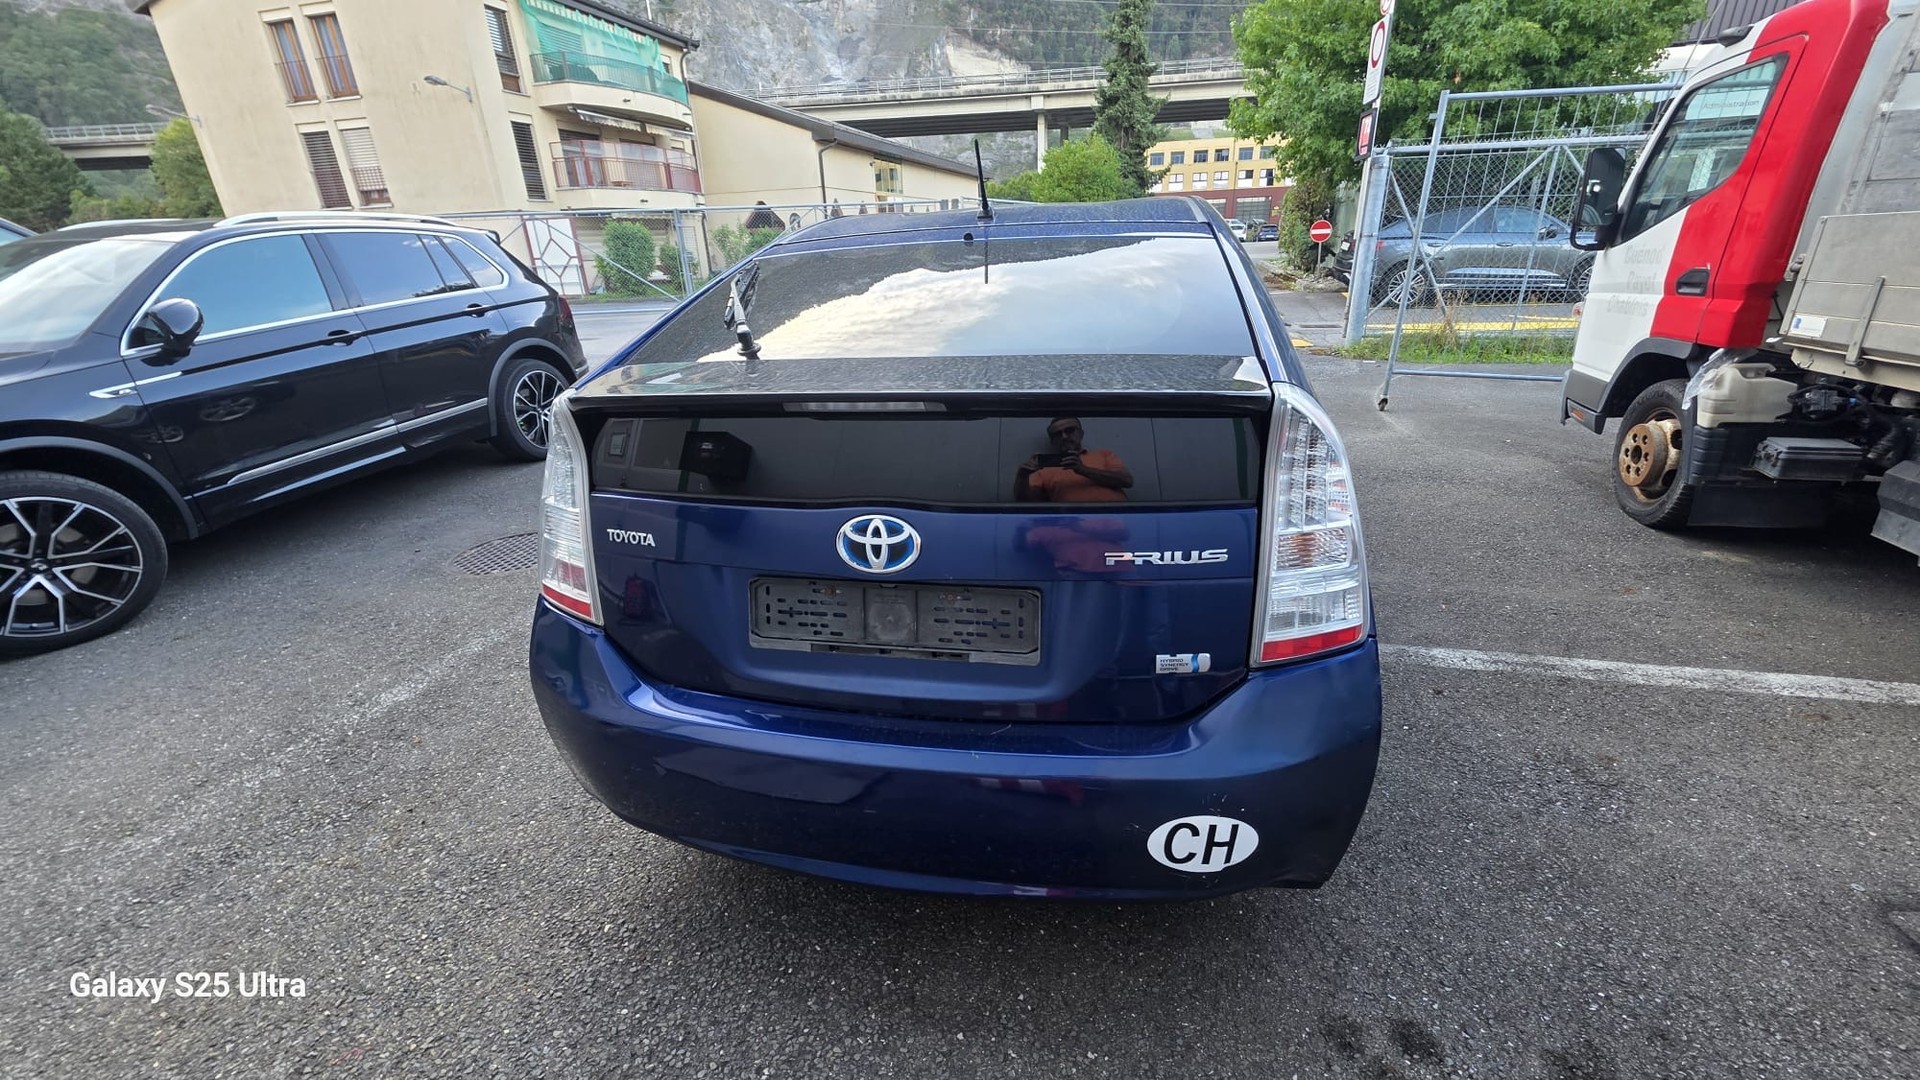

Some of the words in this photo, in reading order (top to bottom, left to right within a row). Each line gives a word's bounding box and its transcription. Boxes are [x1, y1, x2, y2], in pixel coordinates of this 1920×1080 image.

[606, 528, 656, 547] TOYOTA
[1104, 548, 1229, 565] PRIUS
[1163, 822, 1240, 865] CH
